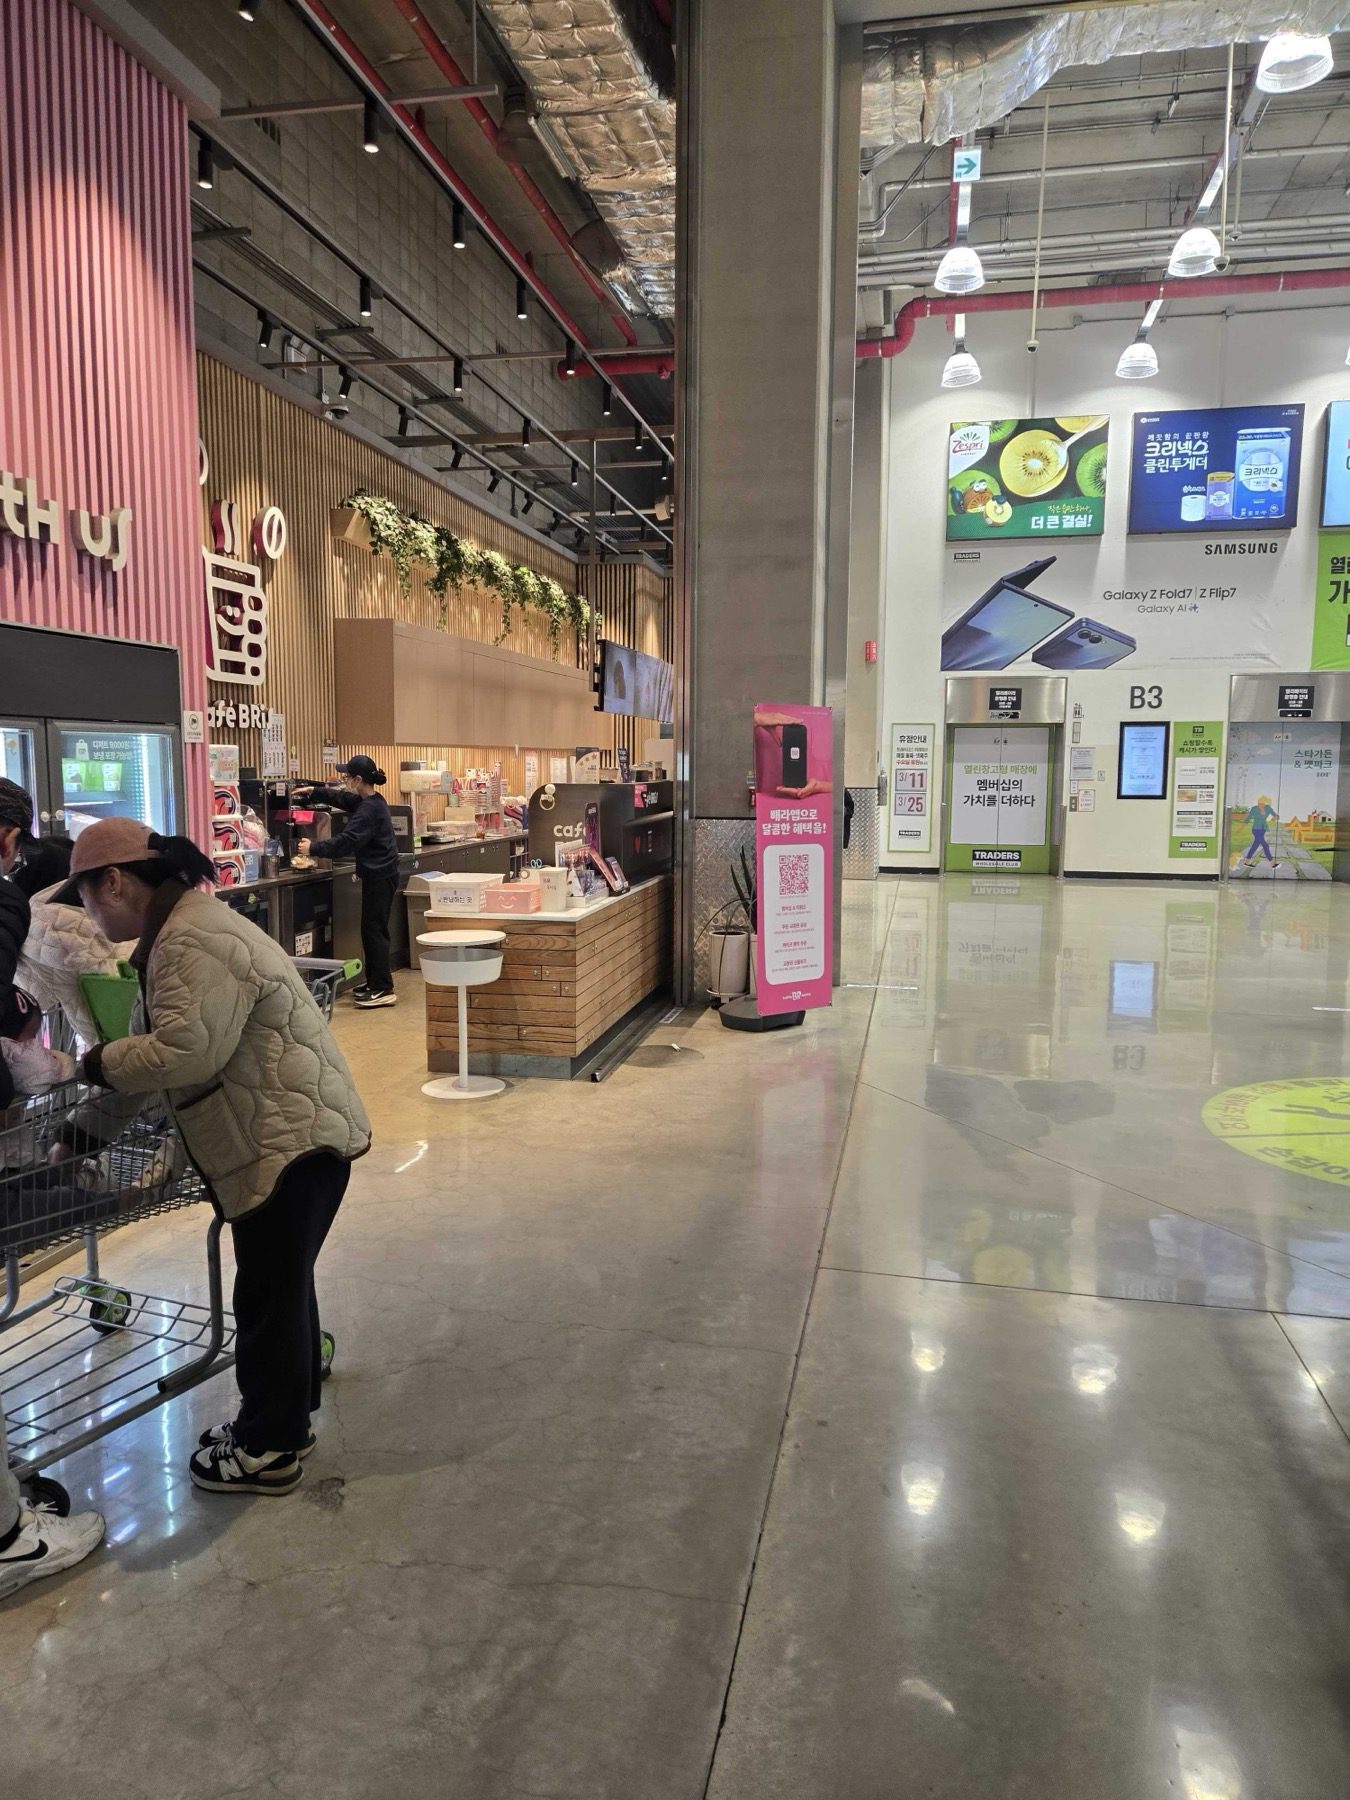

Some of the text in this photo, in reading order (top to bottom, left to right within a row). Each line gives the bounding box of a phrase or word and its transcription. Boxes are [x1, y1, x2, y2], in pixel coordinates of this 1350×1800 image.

[1147, 433, 1180, 441] 깨끗함의
[952, 440, 984, 454] Zespri
[1144, 440, 1209, 457] 크리넥스
[1143, 456, 1208, 474] 클린투게더
[1244, 467, 1278, 476] 크리넥스
[1031, 515, 1093, 529] 더 큰 결실!
[1204, 542, 1279, 556] SAMSUNG
[1103, 587, 1237, 603] Galaxy Z Fold7 Z Flip7
[1137, 604, 1187, 615] Galaxy AI
[1129, 685, 1163, 709] B3
[899, 735, 927, 743] 휴점안내
[1294, 749, 1333, 759] 스타가든
[963, 765, 1038, 775] 열린창고형 매장에
[1294, 760, 1333, 769] & 펫파크
[976, 779, 1023, 792] 멤버십의
[963, 795, 1036, 807] 가치를 더하다
[770, 809, 818, 821] 배라앱으로
[762, 822, 790, 835] 달콤한
[974, 851, 1020, 860] TRADERS
